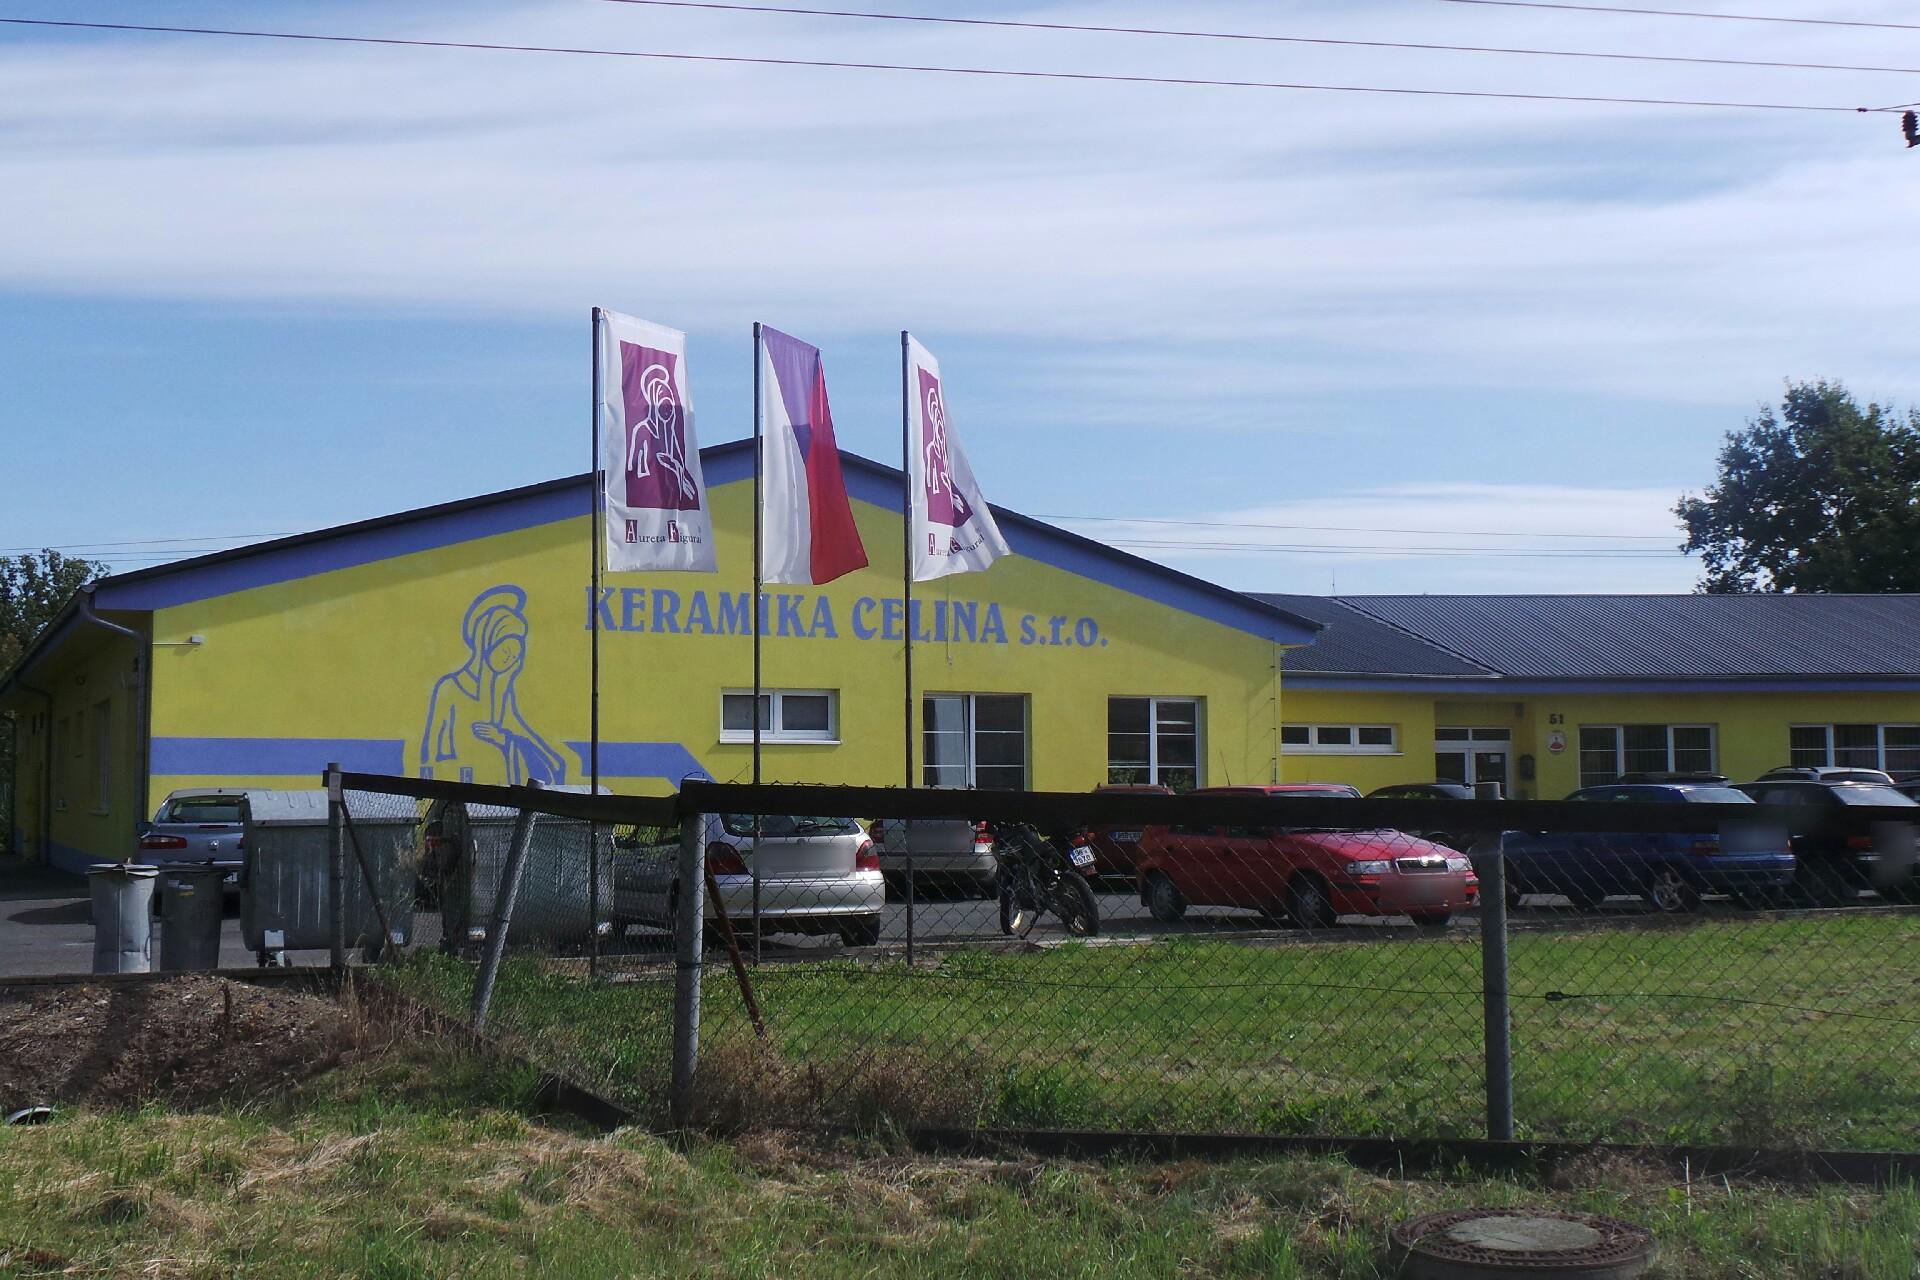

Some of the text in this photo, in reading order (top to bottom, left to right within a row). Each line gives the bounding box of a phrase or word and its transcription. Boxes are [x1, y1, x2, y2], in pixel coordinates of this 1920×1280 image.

[585, 587, 1108, 647] KERAMIKA CELINA s.r.o.
[1549, 713, 1563, 725] 51
